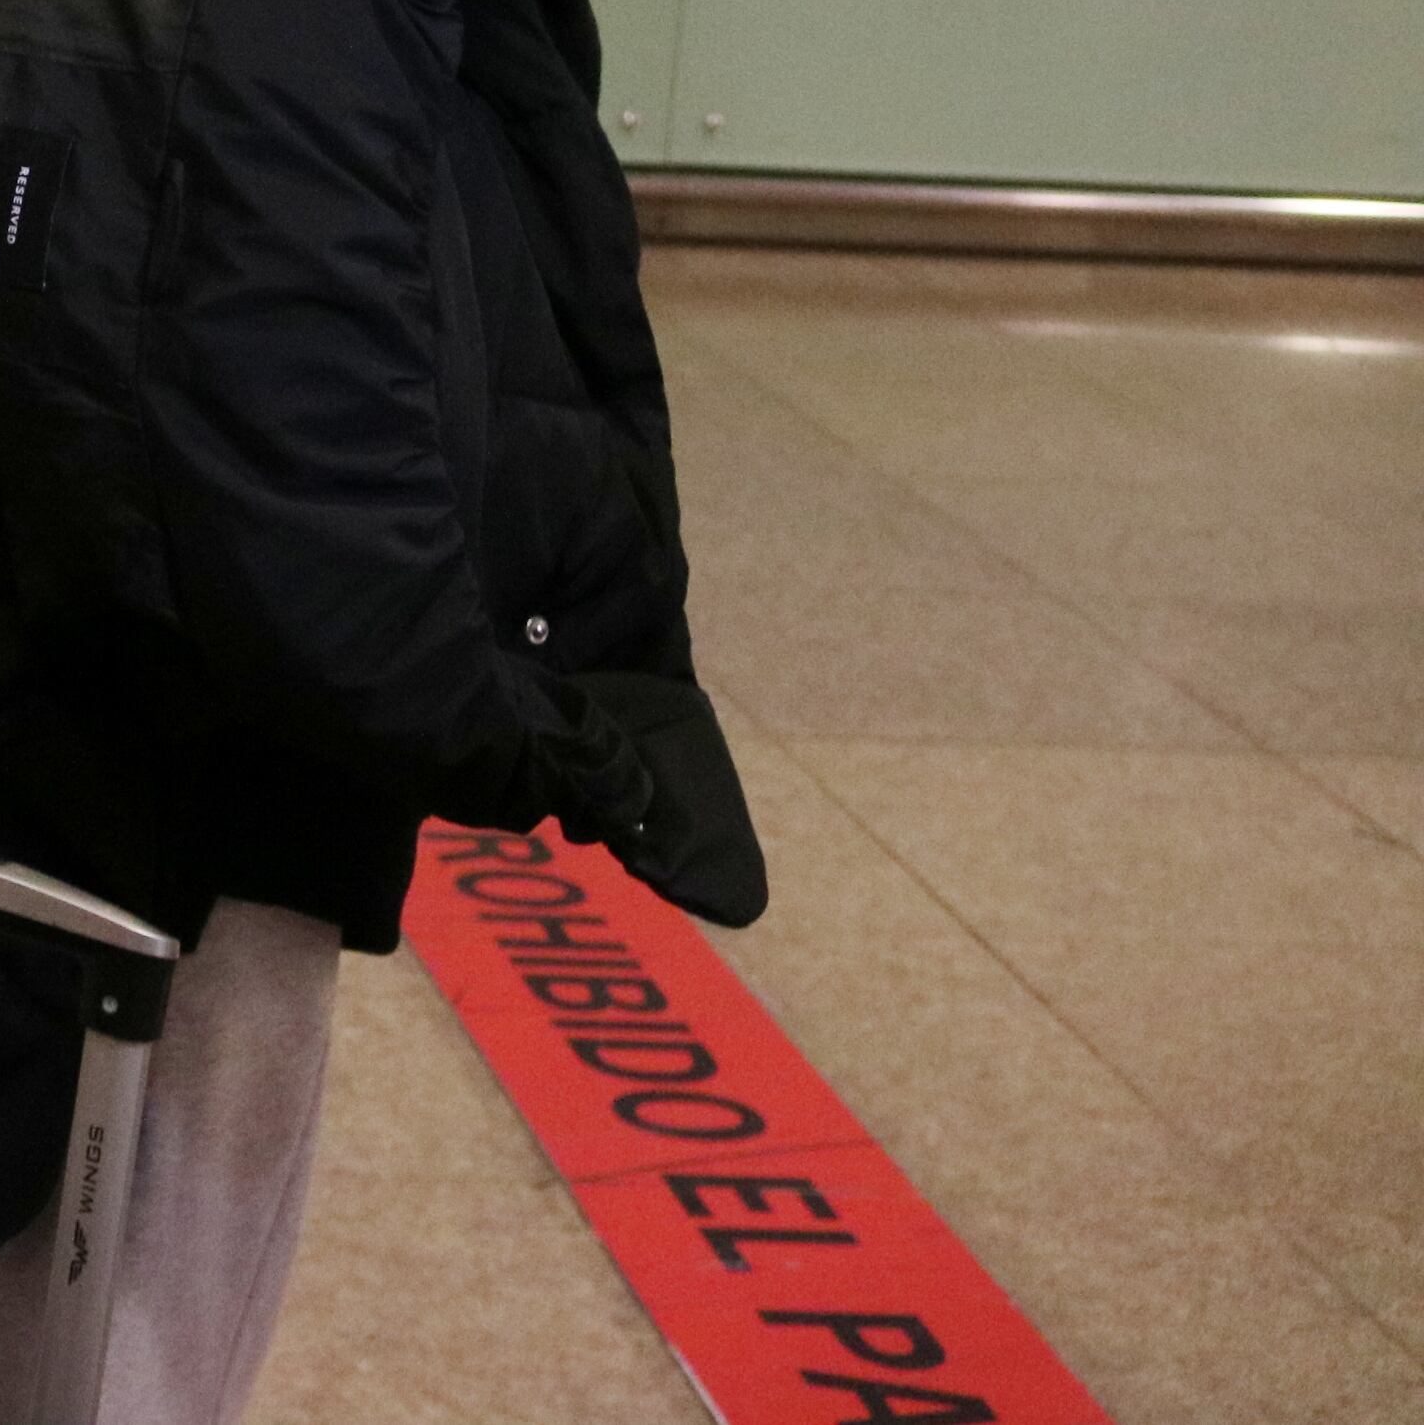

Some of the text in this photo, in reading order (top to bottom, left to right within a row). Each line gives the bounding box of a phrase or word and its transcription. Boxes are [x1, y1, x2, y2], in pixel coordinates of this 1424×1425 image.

[6, 165, 30, 245] RESERVED
[420, 829, 767, 1142] ROHIBIDO
[662, 1172, 859, 1273] EL
[78, 1125, 104, 1215] WINGS
